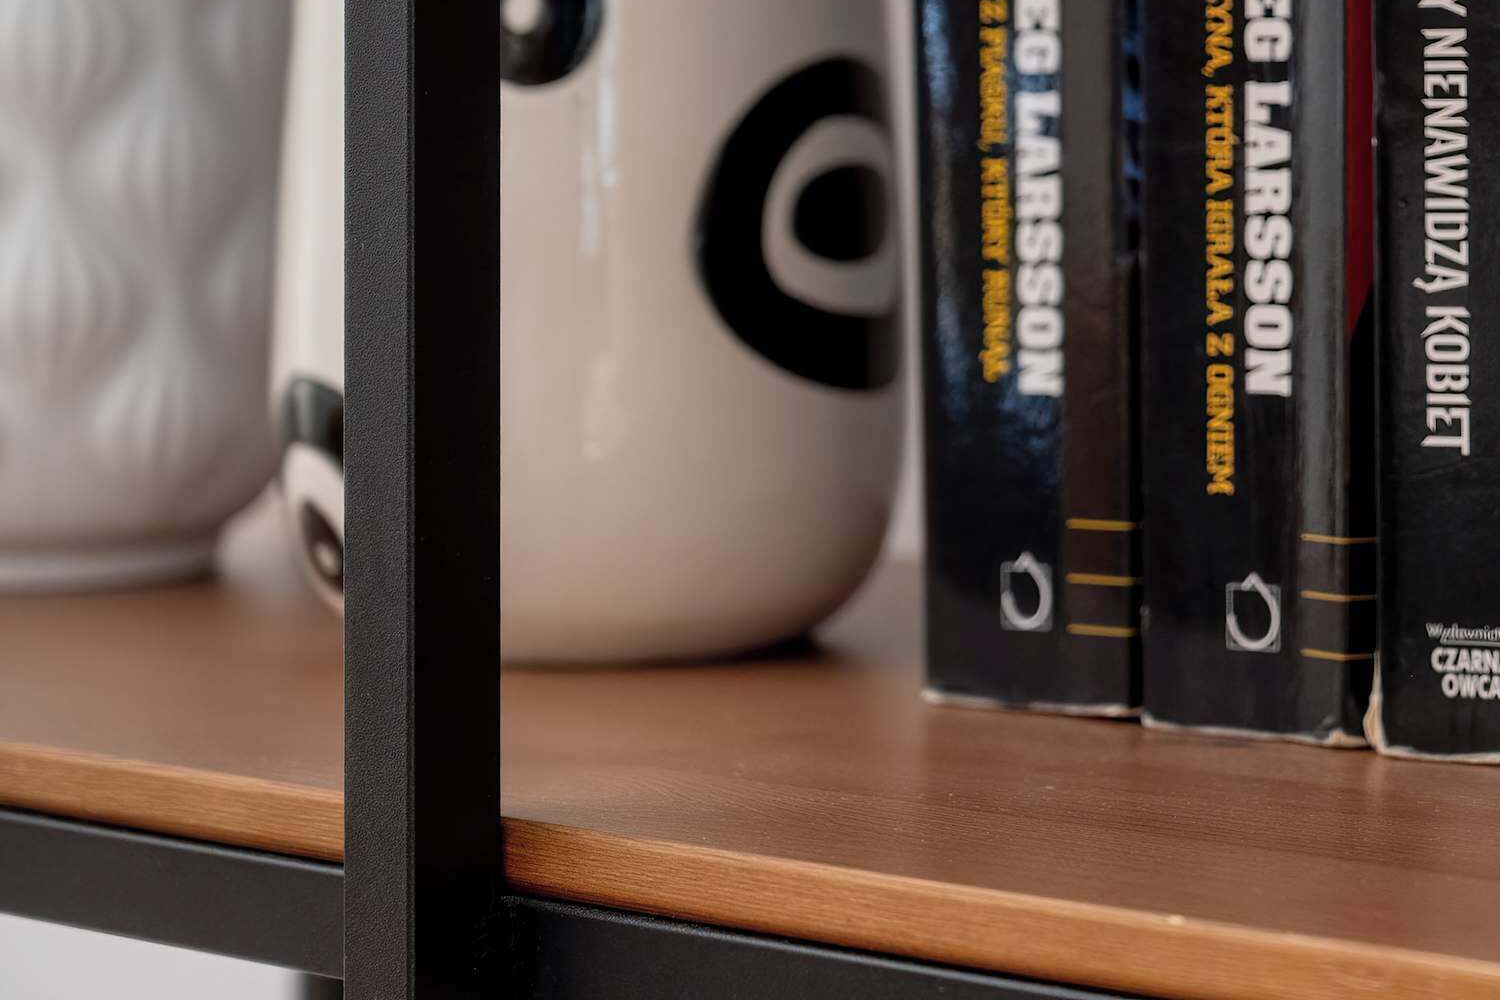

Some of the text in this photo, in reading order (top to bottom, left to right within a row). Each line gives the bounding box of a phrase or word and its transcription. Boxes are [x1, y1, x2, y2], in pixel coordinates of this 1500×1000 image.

[1204, 83, 1240, 196] KTÓRA
[1412, 27, 1471, 294] NIENAWIDZĄ
[1013, 90, 1065, 398] LARSSON
[1205, 199, 1235, 328] IGRAŁA
[1243, 80, 1293, 398] LARSSON
[1205, 331, 1235, 358] Z
[1420, 305, 1472, 457] KOBIET
[1205, 362, 1236, 497] OGNIEM
